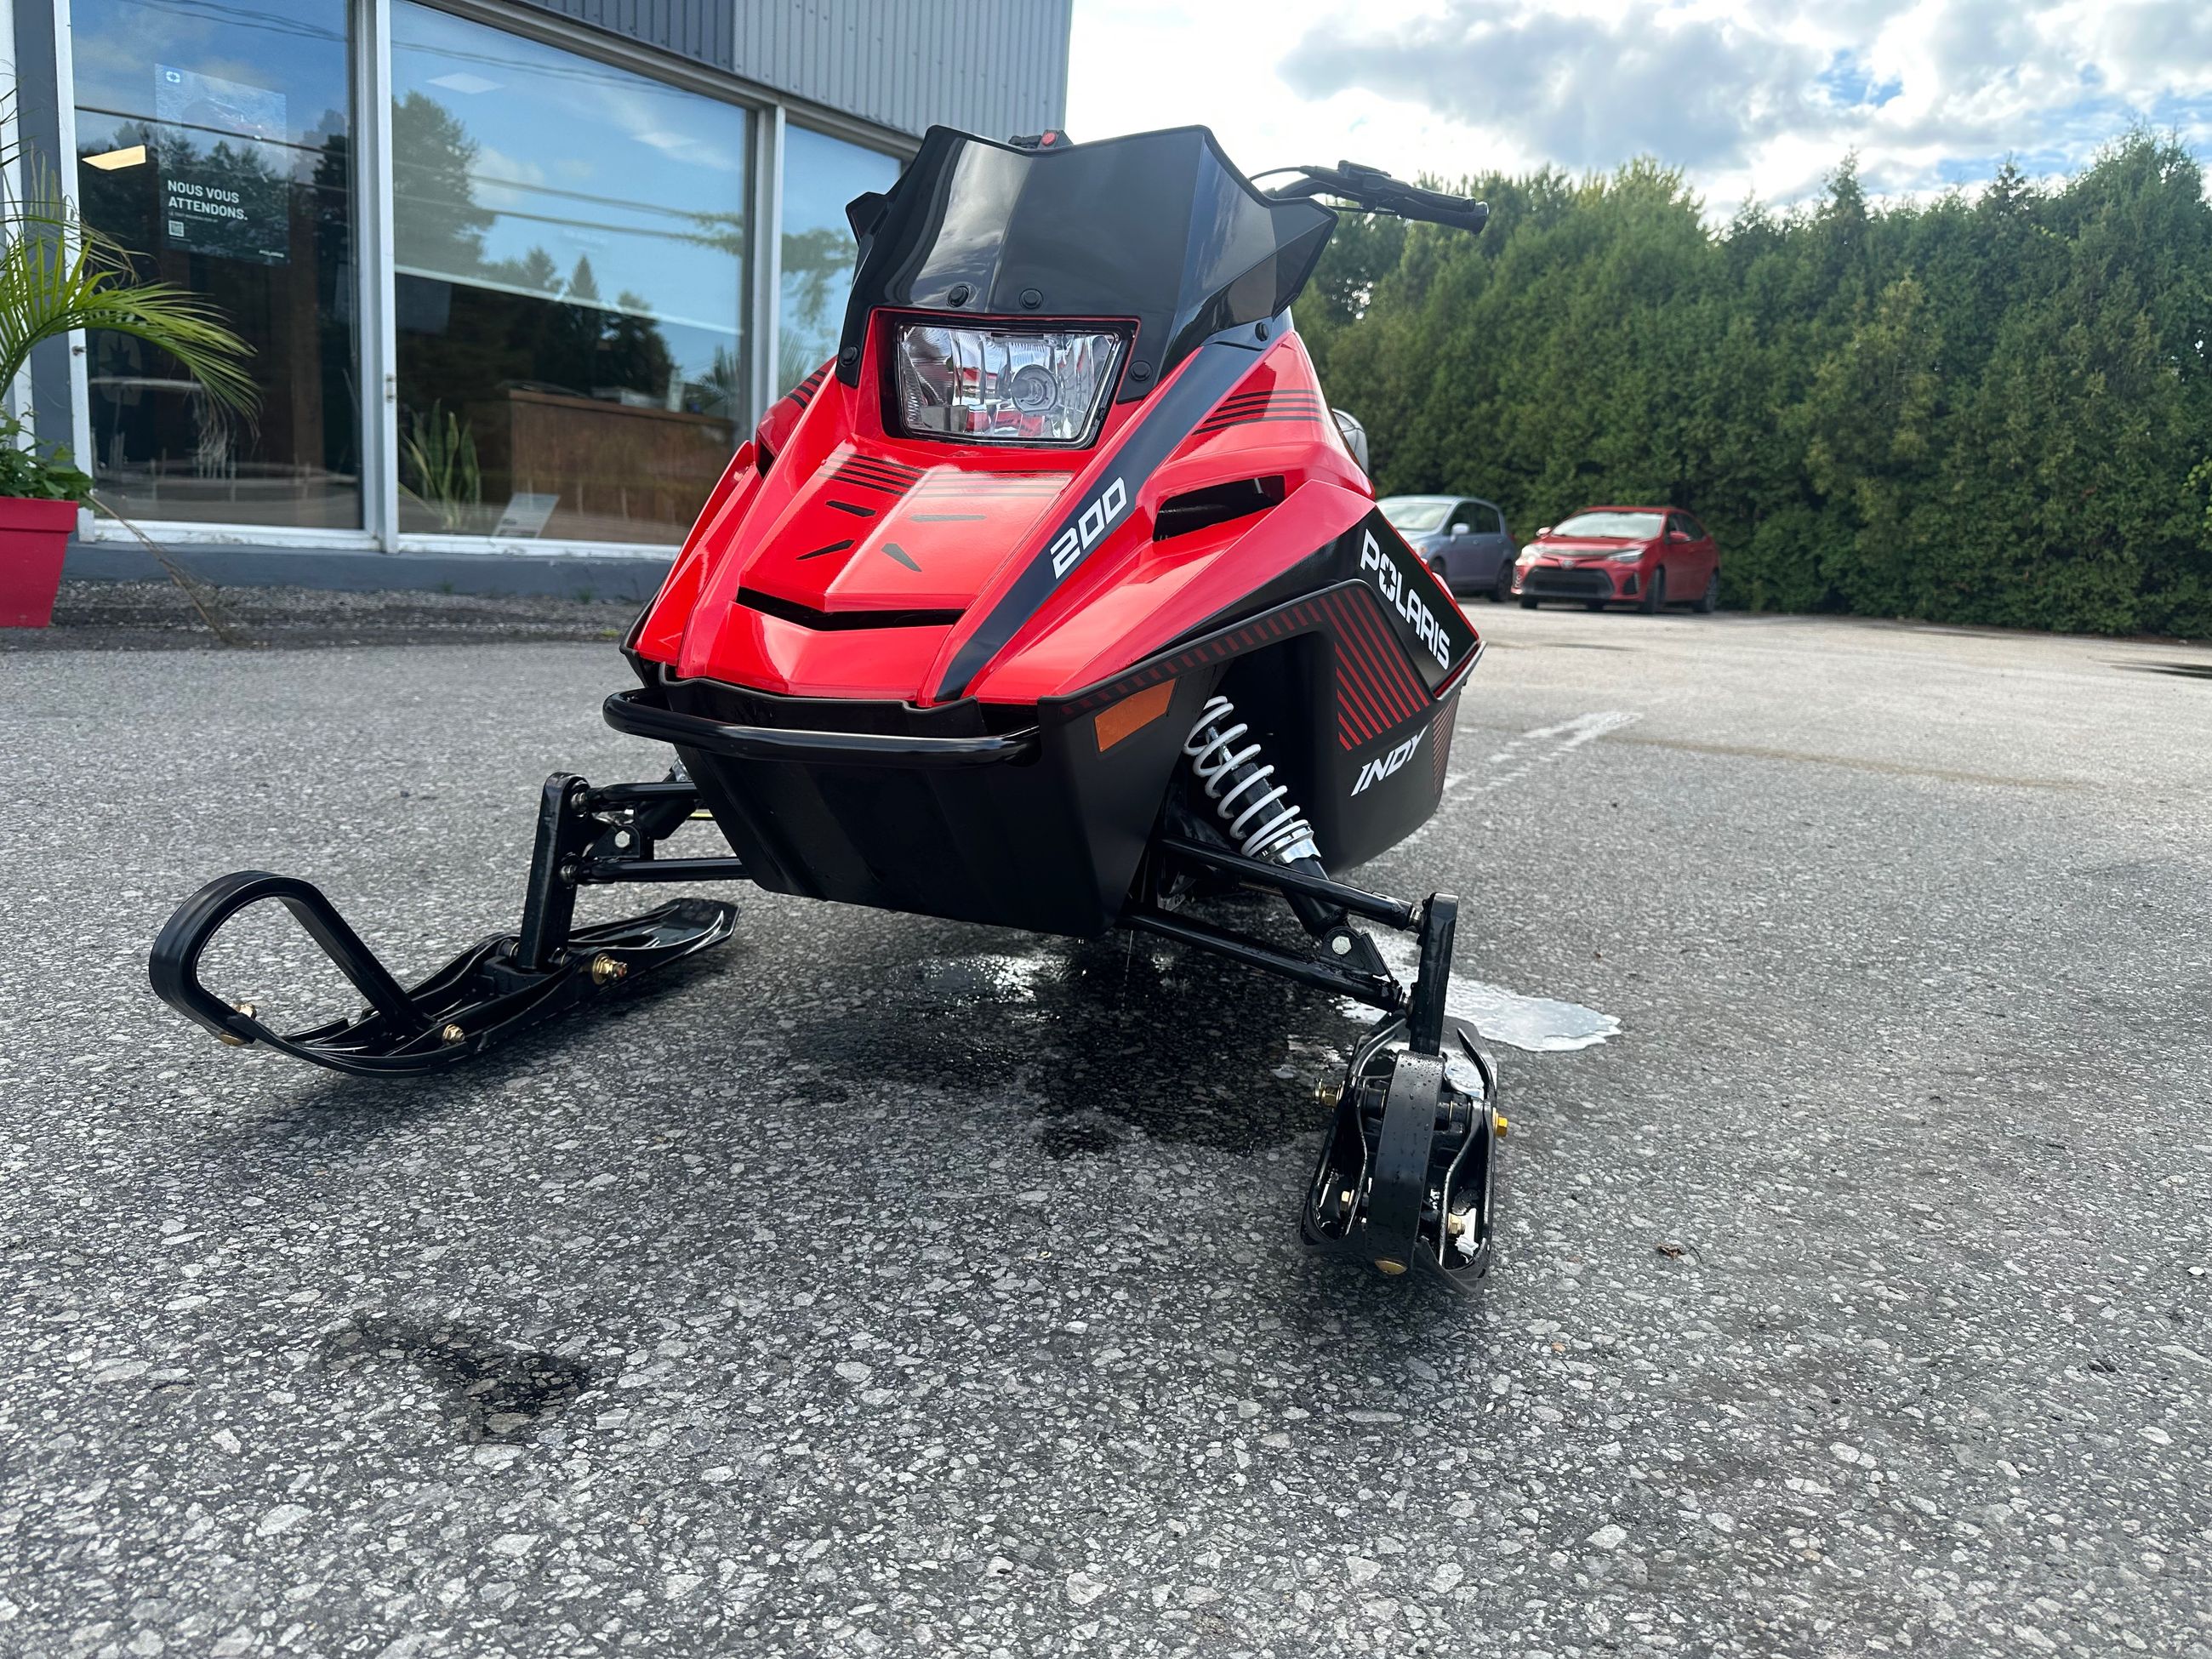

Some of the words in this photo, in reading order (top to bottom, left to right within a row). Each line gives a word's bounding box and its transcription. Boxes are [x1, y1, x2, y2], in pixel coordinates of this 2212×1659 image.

[168, 180, 203, 197] NOUS
[205, 186, 239, 203] VOUS
[168, 196, 248, 220] ATTENDONS.
[1050, 476, 1127, 579] 200
[1360, 528, 1451, 670] POLARIS
[1350, 725, 1429, 796] INDY
